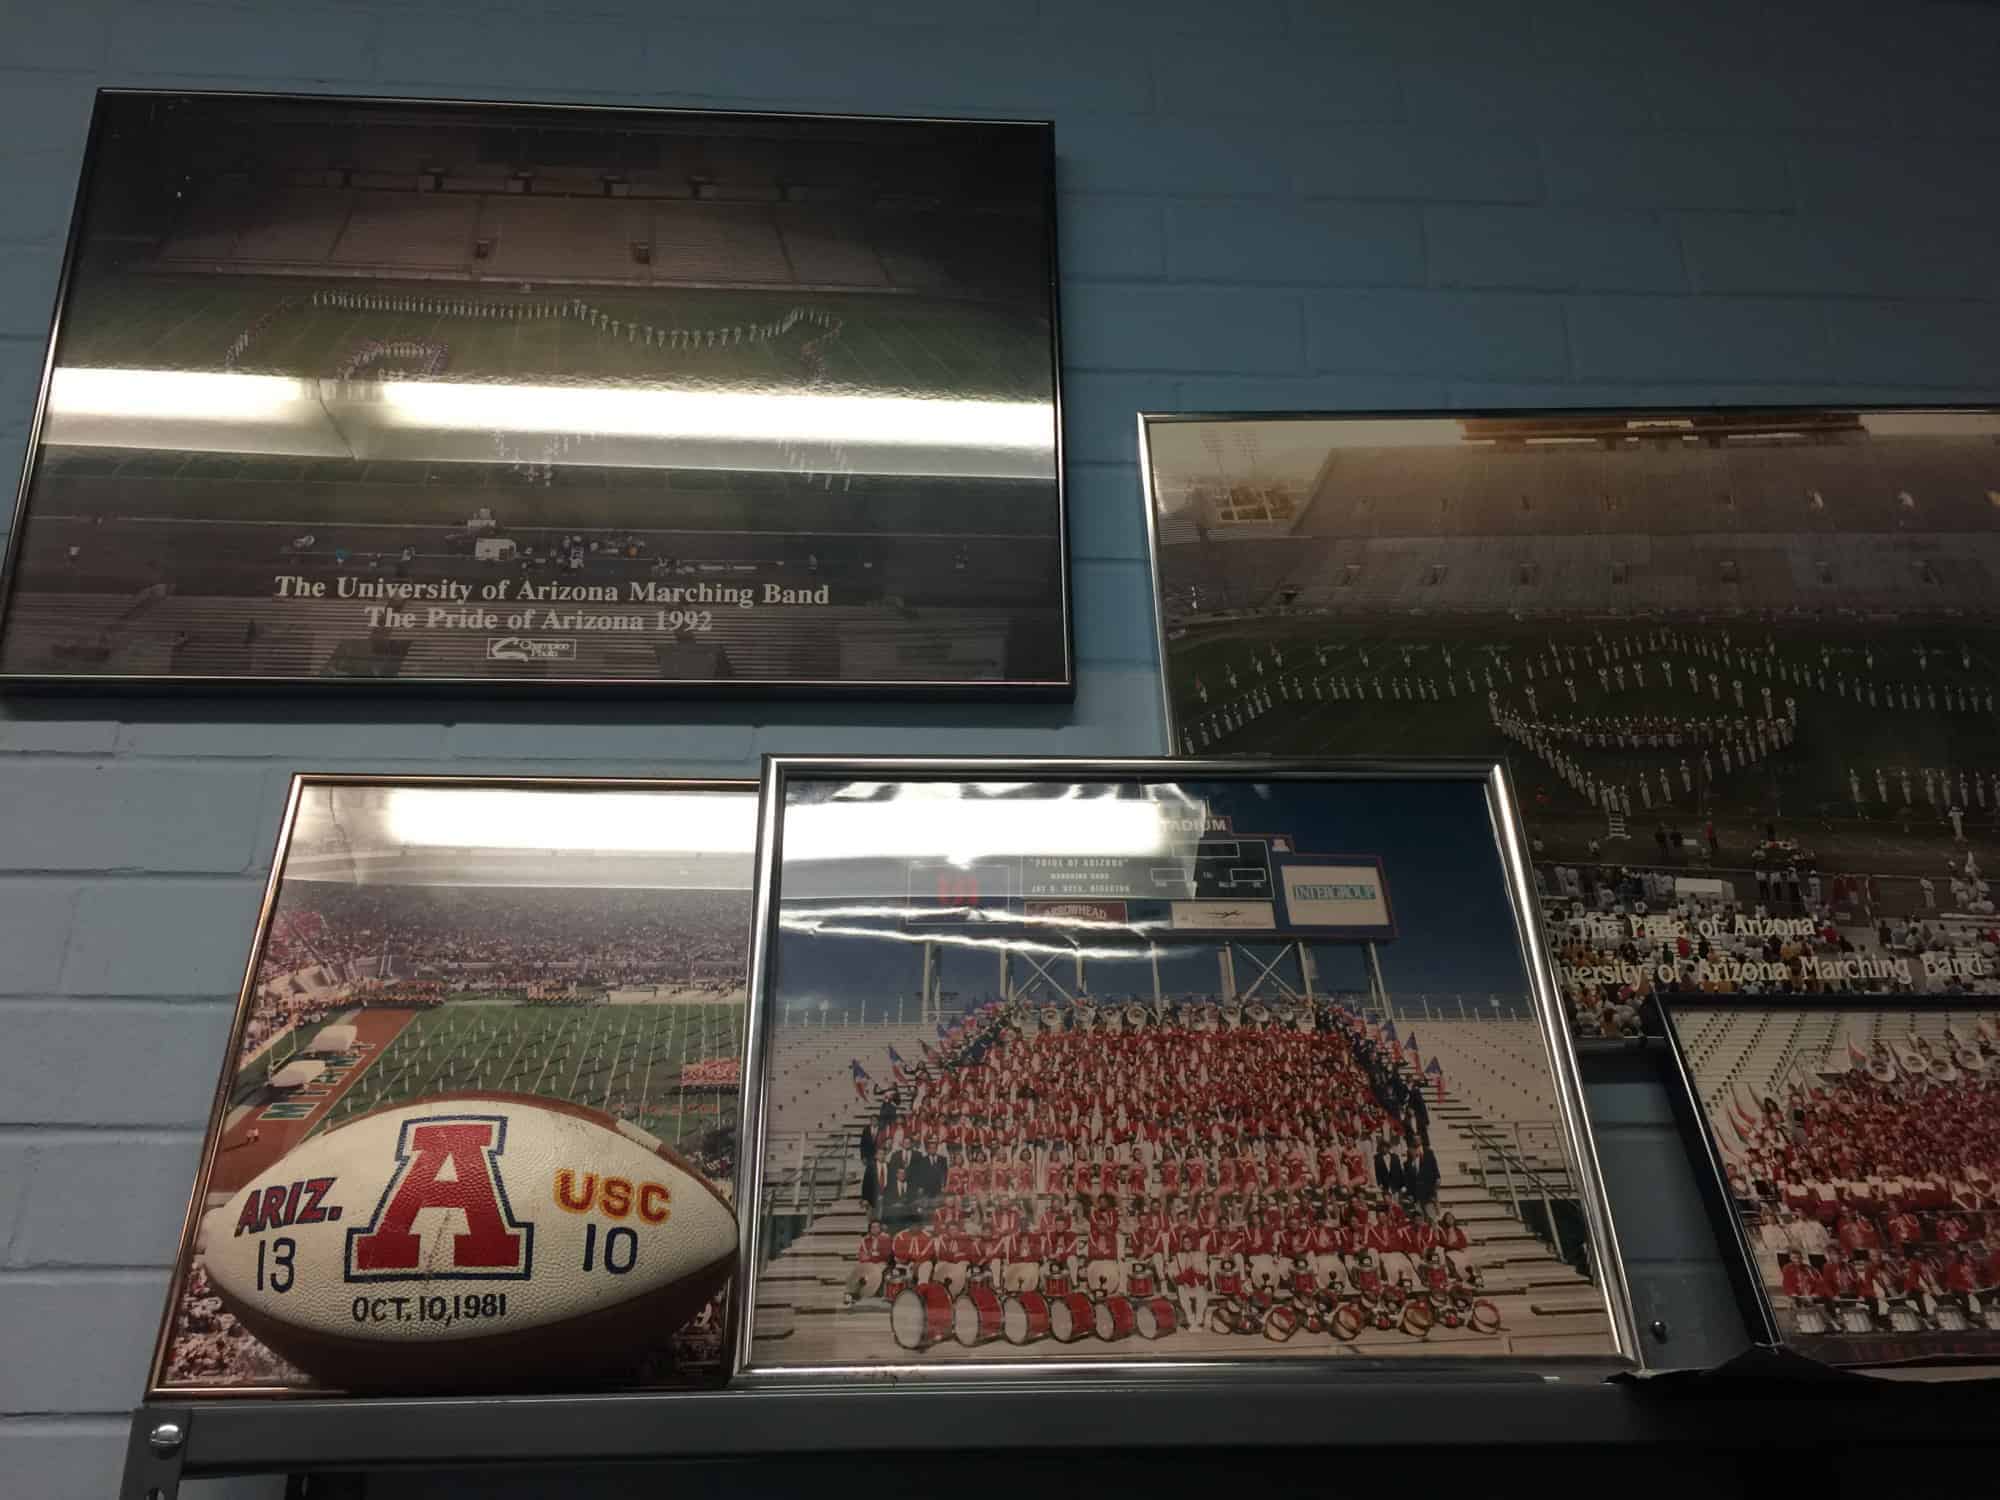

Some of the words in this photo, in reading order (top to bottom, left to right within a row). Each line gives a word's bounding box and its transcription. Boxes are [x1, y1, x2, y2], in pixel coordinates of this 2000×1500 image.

[274, 575, 326, 598] The
[337, 577, 473, 605] University
[481, 579, 511, 600] of
[516, 580, 619, 602] Arizona
[629, 581, 754, 608] Marching
[762, 583, 830, 604] Band
[364, 606, 417, 628] The
[425, 606, 499, 630] Pride
[507, 608, 536, 630] of
[540, 609, 644, 631] Arizona
[655, 610, 713, 632] 1992
[1700, 914, 1722, 936] of
[1735, 914, 1816, 937] Arizona
[1658, 956, 1682, 983] of
[1700, 957, 1791, 983] Arizona
[1799, 954, 1912, 984] Marching
[1920, 951, 1985, 977] Band
[234, 1177, 343, 1237] ARIZ.
[554, 1168, 671, 1225] USC
[256, 1237, 297, 1294] 13
[582, 1223, 639, 1275] 10
